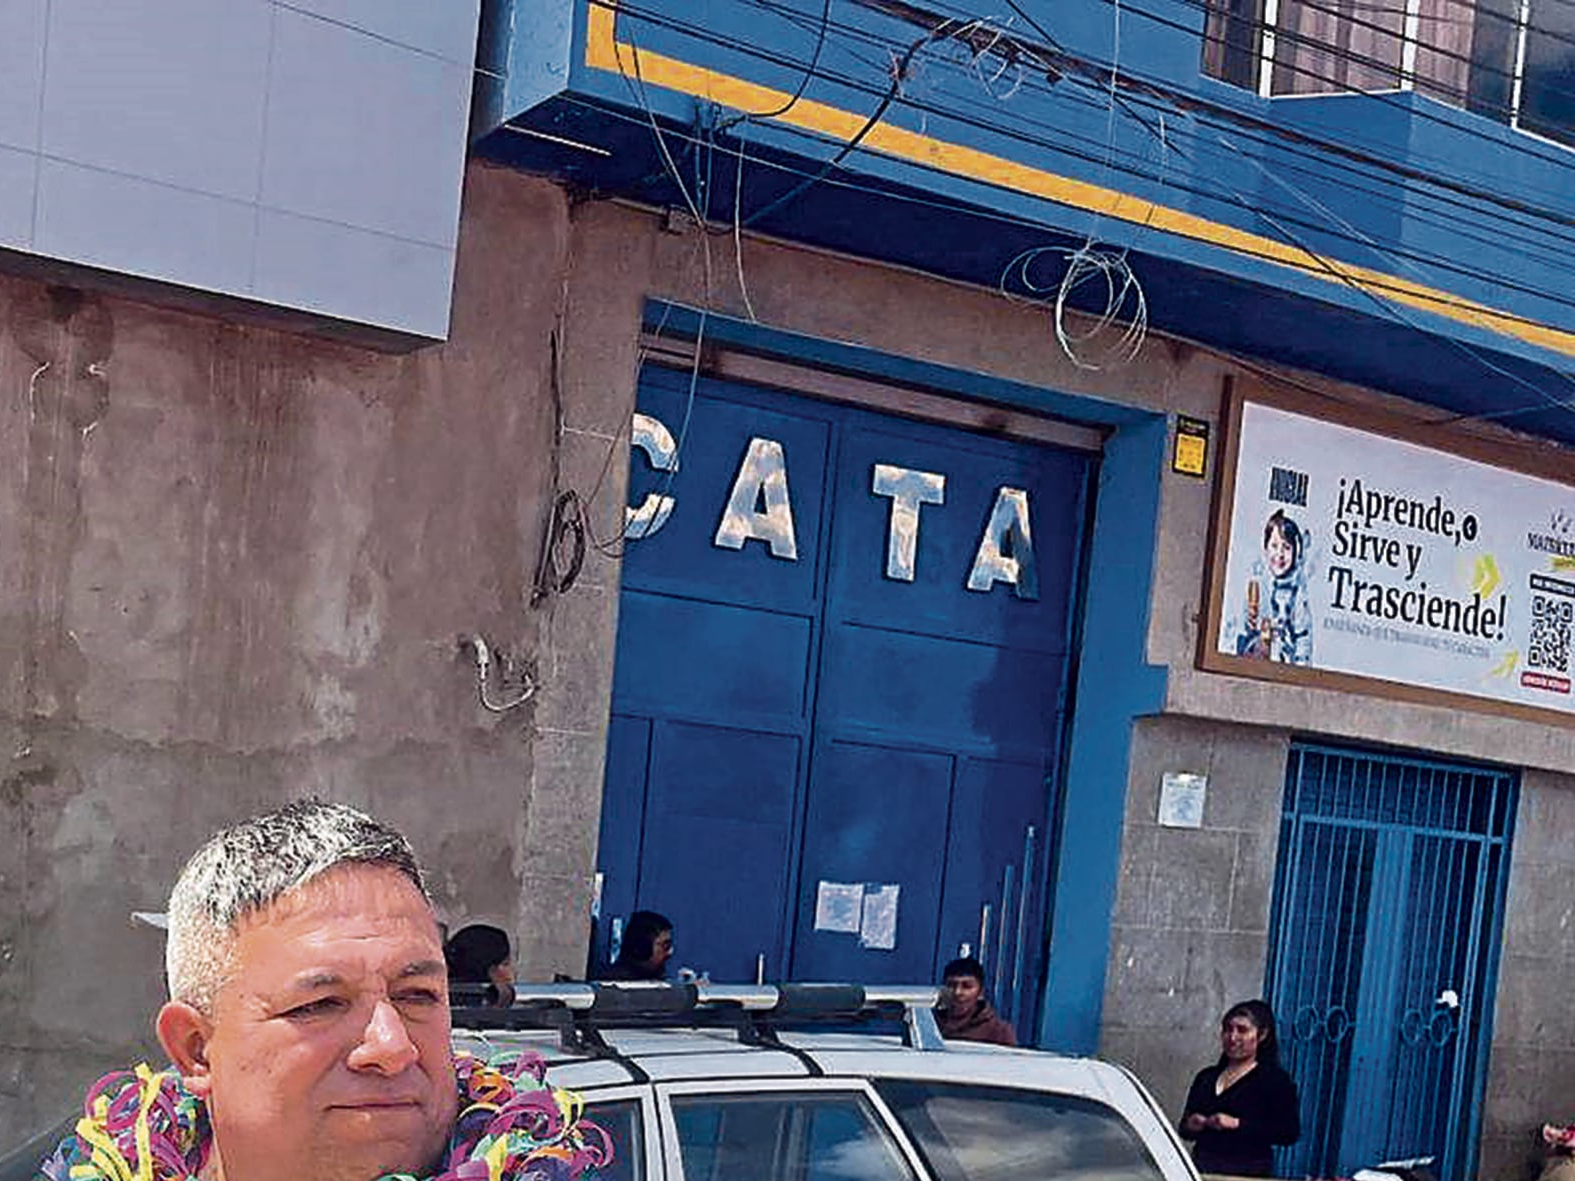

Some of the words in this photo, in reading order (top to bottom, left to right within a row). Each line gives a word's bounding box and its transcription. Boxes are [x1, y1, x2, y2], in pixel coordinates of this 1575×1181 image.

[624, 413, 1040, 600] CATA
[1336, 478, 1461, 547] ¡Aprende,
[1332, 521, 1400, 568] Sirve
[1405, 544, 1422, 581] y
[1328, 566, 1507, 641] Trasciende!
